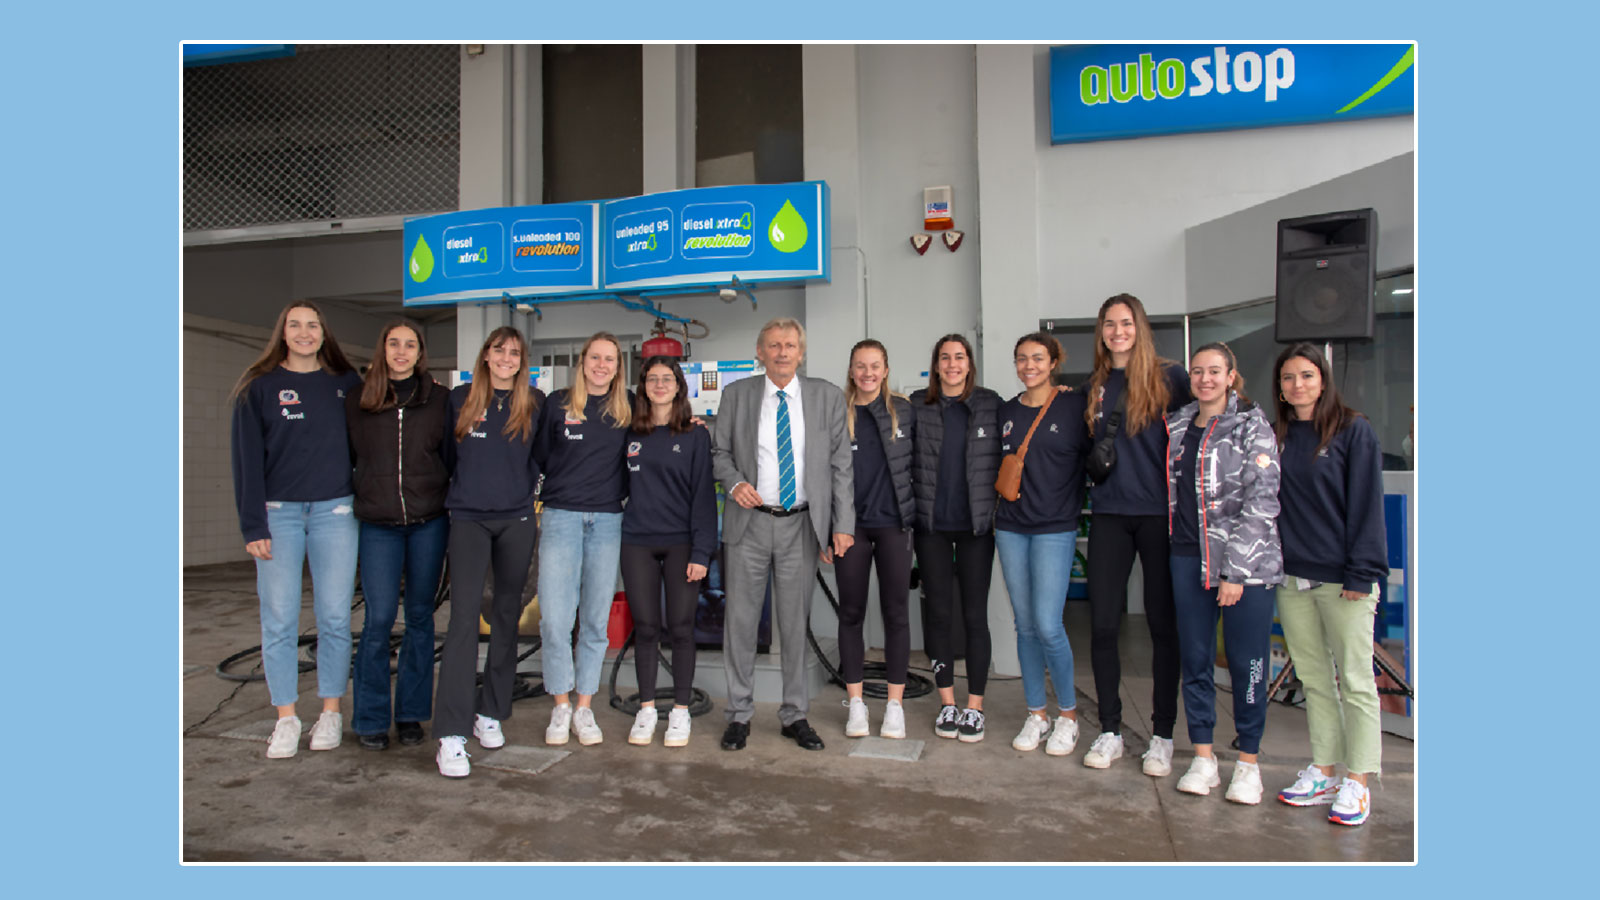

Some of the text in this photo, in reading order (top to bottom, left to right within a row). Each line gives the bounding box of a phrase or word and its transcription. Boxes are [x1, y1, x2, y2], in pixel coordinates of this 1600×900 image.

[616, 219, 669, 239] unleaded 95
[683, 217, 713, 231] diesel
[446, 237, 472, 250] diesel
[513, 232, 580, 243] s.unleaded 100
[683, 233, 751, 250] revolution
[515, 242, 580, 258] revolution
